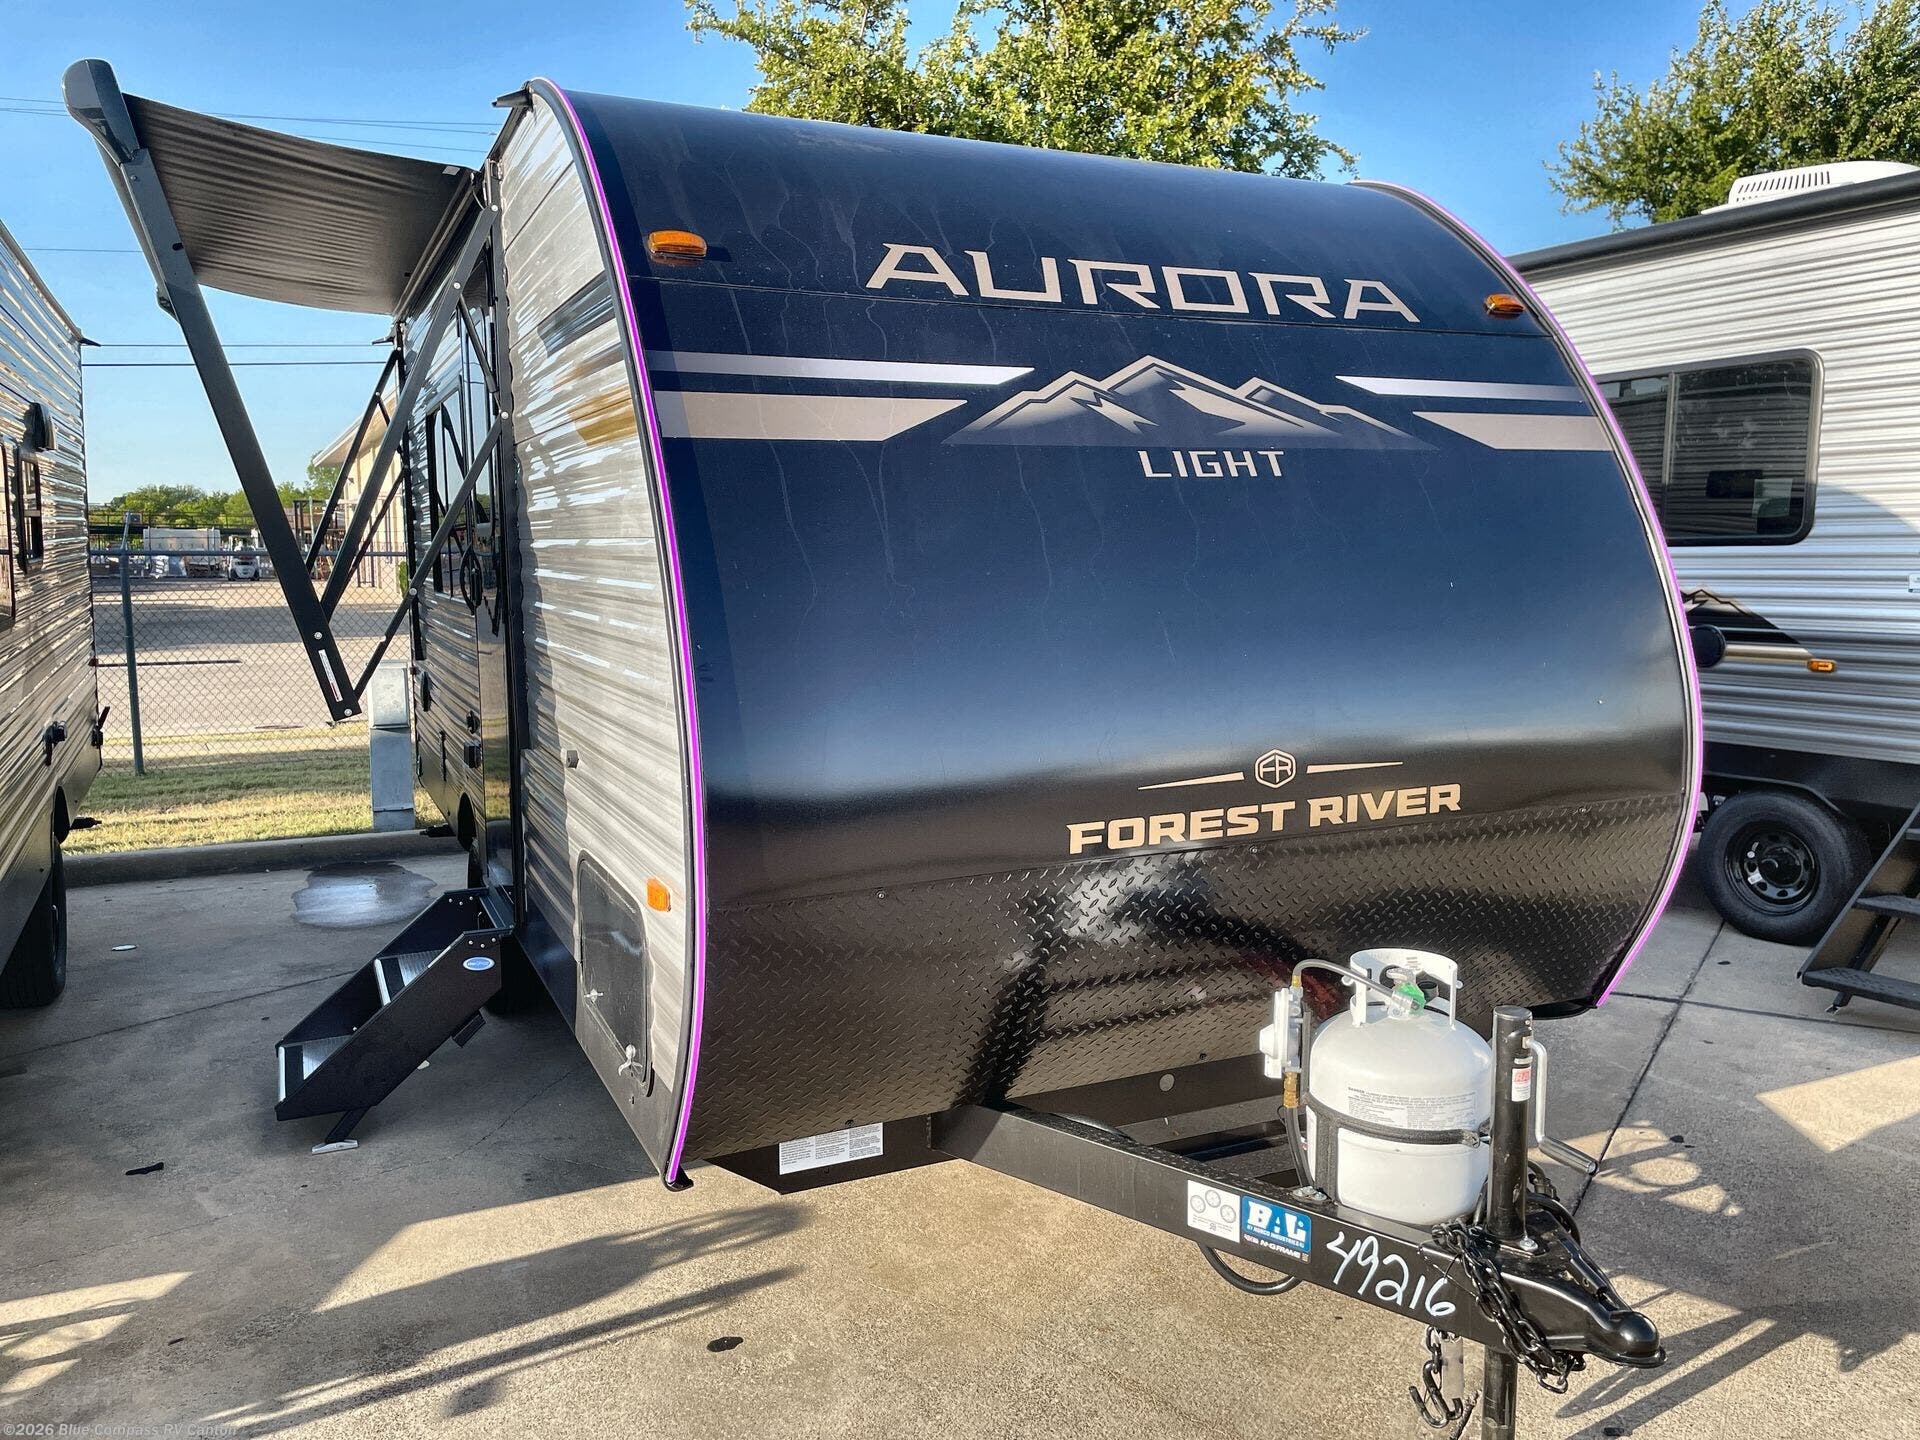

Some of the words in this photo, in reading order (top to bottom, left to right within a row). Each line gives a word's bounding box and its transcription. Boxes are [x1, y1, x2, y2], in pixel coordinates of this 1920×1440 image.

[865, 242, 1420, 322] AURORA
[1137, 450, 1284, 478] LIGHT
[1066, 801, 1296, 855] FOREST
[1306, 783, 1462, 827] RIVER
[1247, 1200, 1307, 1243] BAL
[1326, 1231, 1457, 1317] 49216
